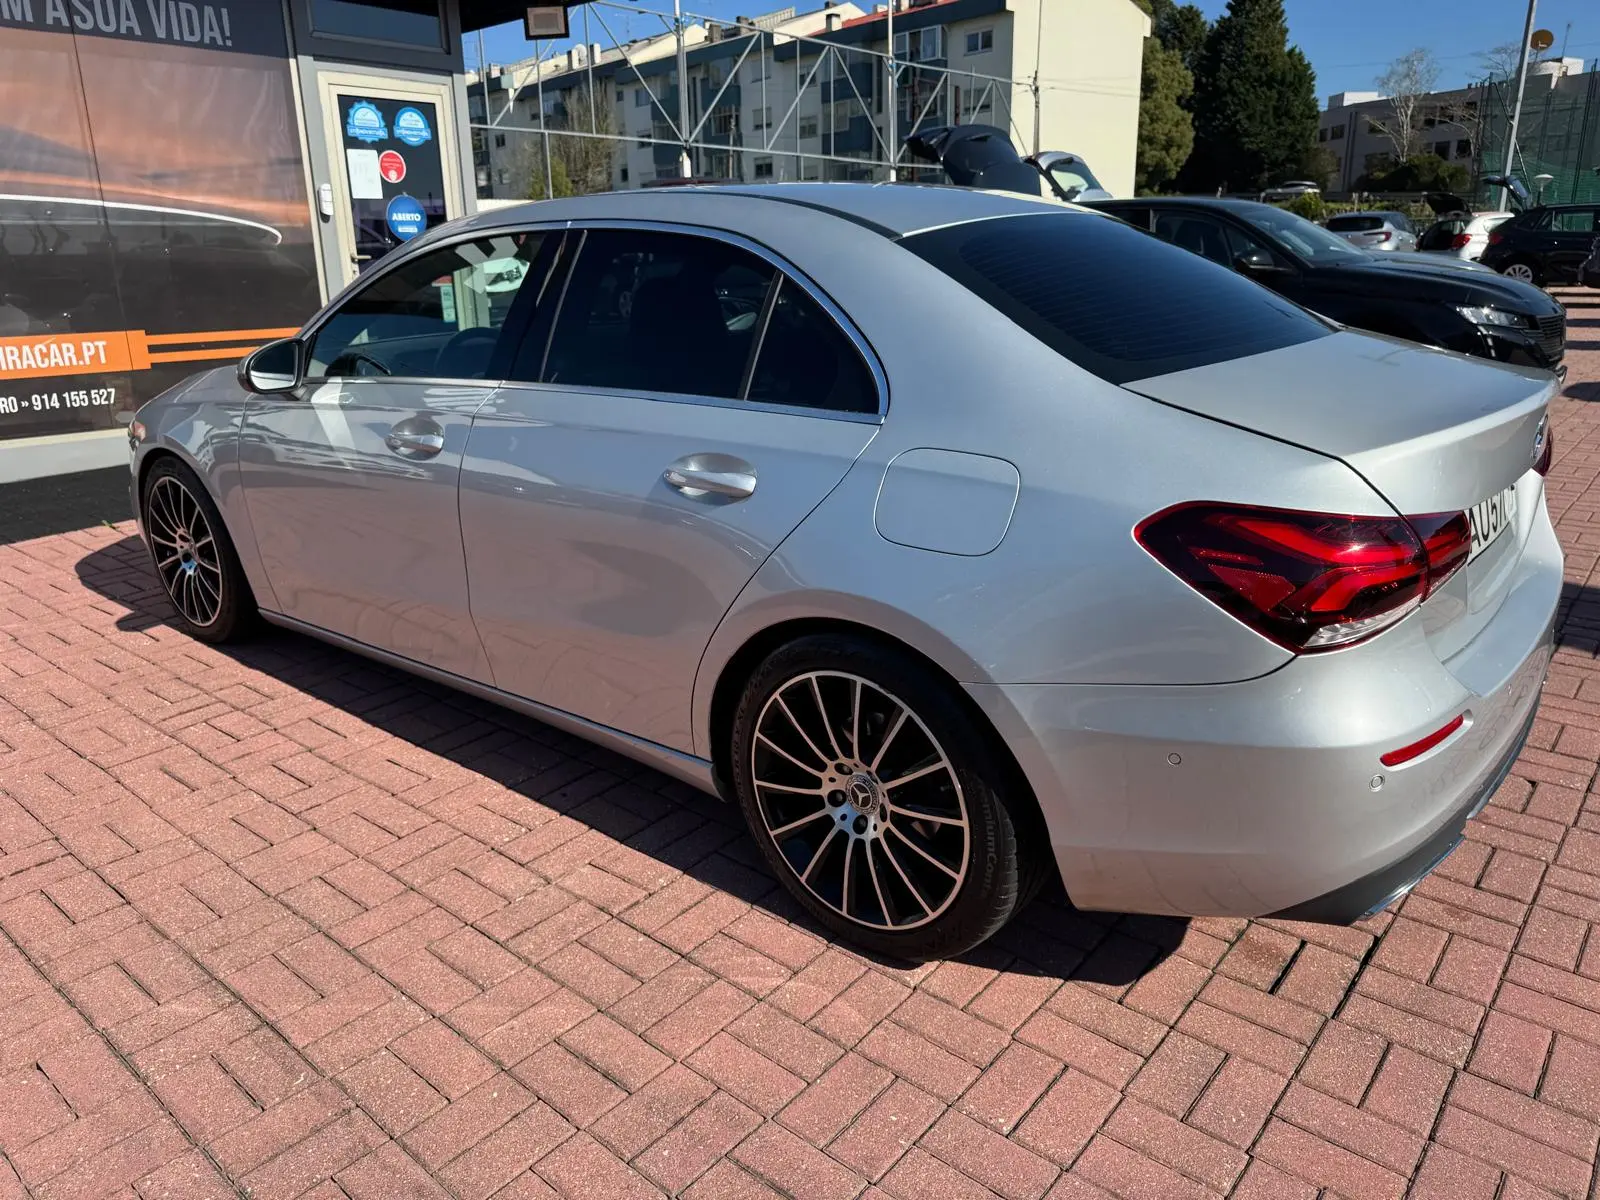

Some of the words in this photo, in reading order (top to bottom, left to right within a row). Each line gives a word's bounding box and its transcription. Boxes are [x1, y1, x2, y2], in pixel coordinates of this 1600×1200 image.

[147, 0, 232, 46] VIDA!
[392, 212, 421, 222] ABERTO
[31, 393, 60, 411] 914
[62, 390, 89, 408] 155
[90, 388, 116, 406] 527
